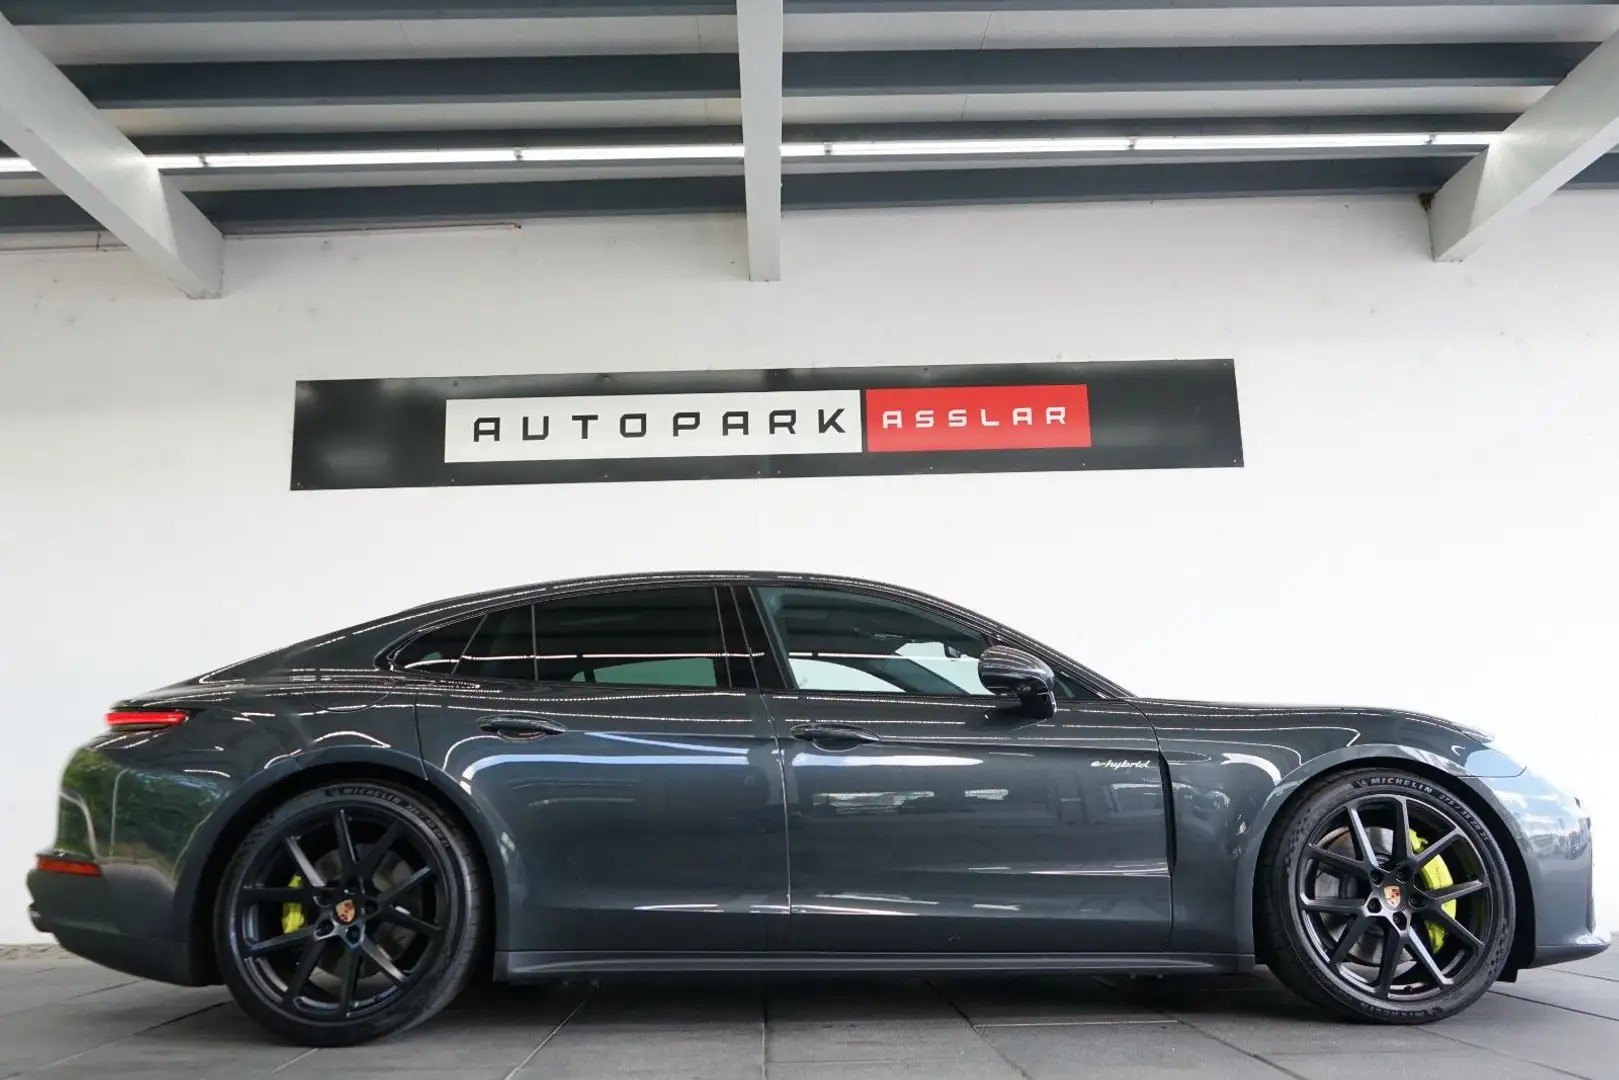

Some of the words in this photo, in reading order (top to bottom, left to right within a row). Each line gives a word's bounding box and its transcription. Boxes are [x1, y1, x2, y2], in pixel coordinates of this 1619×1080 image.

[473, 408, 846, 442] AUTOPARK
[882, 406, 1066, 429] ASSLAR
[1090, 759, 1151, 771] e-hybrid
[1370, 777, 1433, 793] MICHELIN
